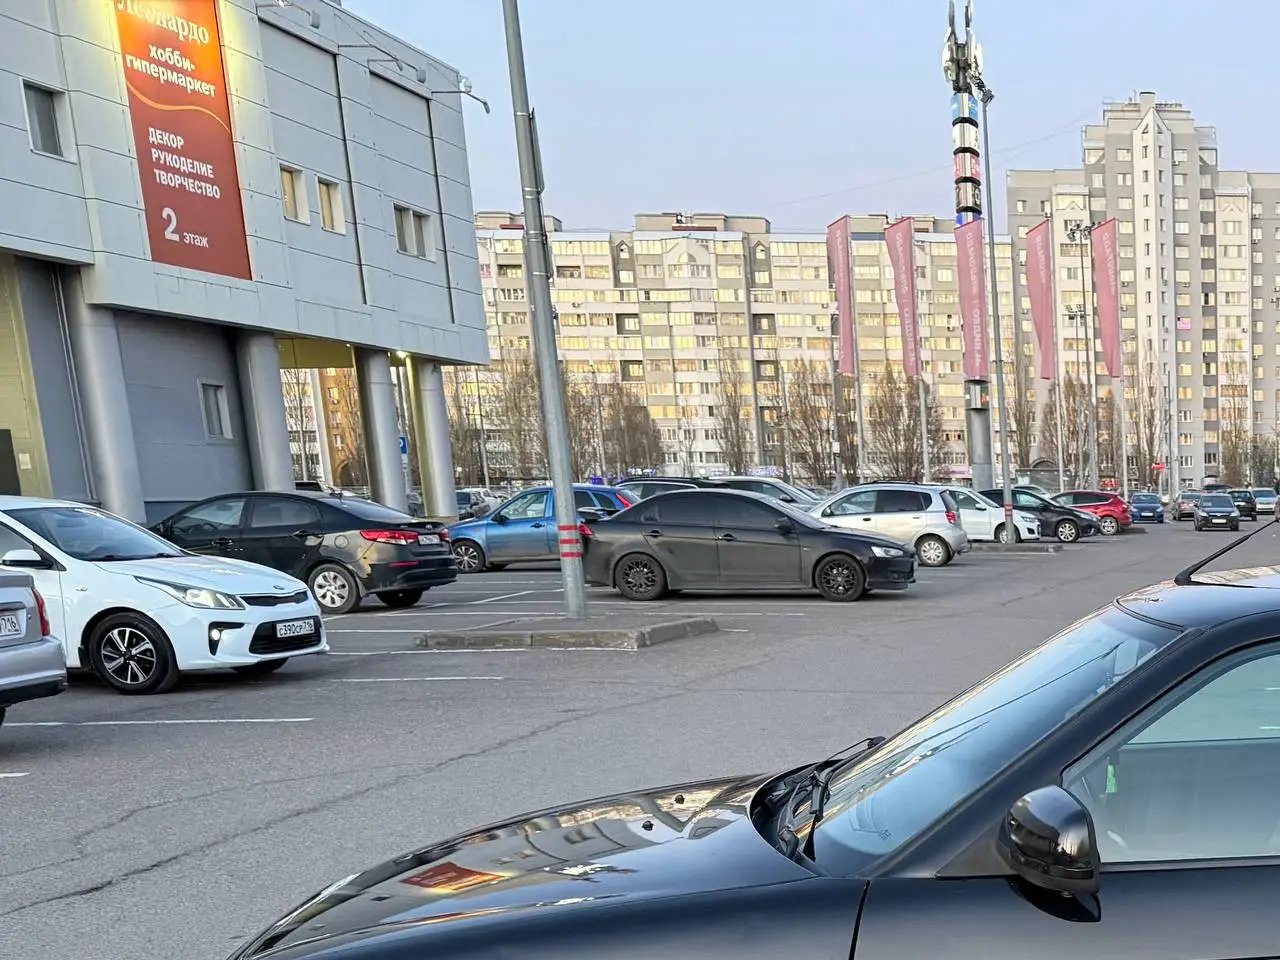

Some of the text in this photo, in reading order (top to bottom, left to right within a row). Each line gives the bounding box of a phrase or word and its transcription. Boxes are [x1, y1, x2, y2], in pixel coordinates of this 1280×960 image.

[148, 43, 196, 72] хобби-
[125, 53, 216, 98] гипермаркет
[148, 127, 185, 150] ДЕКОР
[151, 148, 214, 179] РУКОДЕЛИЕ
[153, 168, 221, 199] ТВОРЧЕСТВО
[161, 206, 209, 249] 2 этаж
